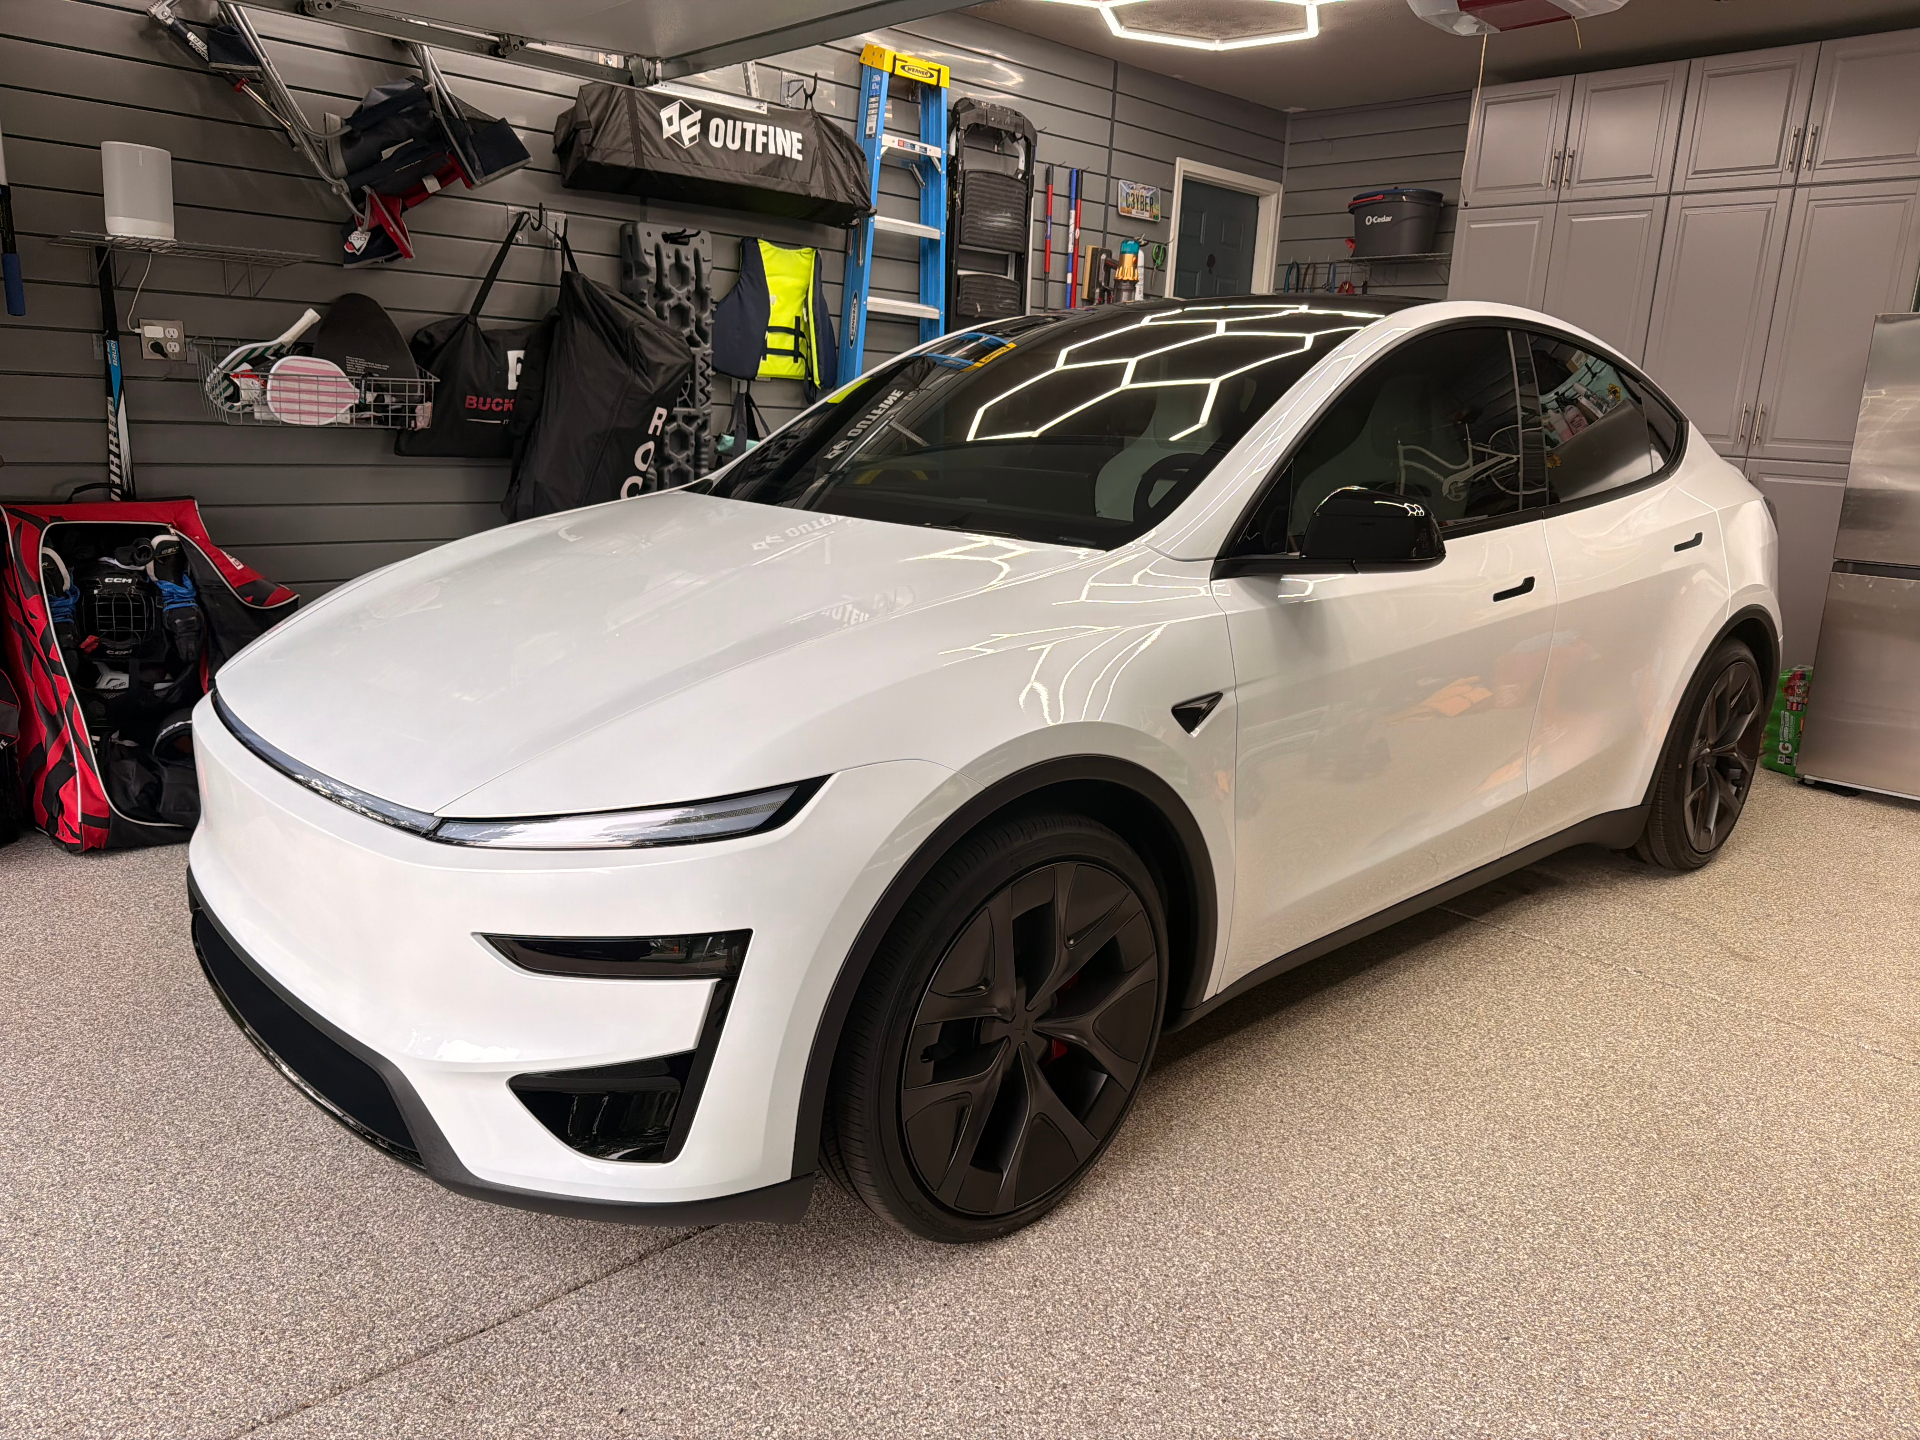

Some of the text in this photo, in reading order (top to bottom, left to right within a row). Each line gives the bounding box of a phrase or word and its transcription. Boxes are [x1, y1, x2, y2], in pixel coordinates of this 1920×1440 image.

[907, 66, 929, 76] WERNER
[708, 117, 803, 161] OUTFINE
[1126, 192, 1154, 213] C3YBER
